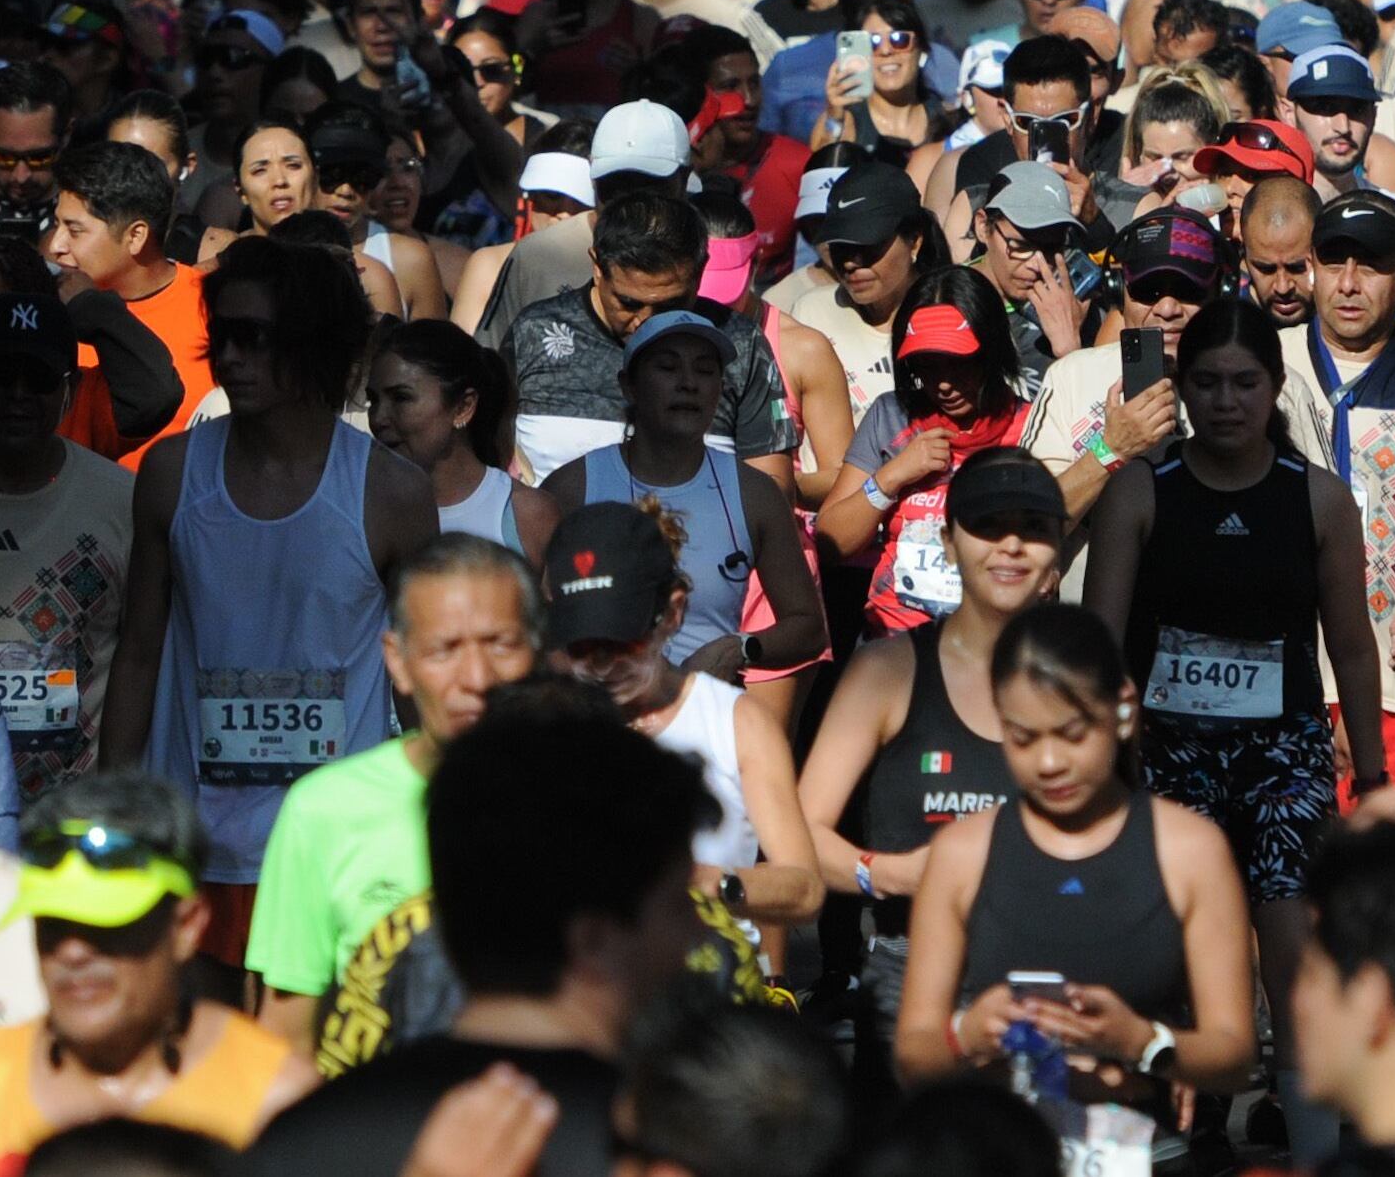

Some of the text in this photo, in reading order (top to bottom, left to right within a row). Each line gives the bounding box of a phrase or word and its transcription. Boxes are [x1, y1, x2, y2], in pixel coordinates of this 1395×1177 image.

[1215, 527, 1250, 536] adidas
[1167, 658, 1260, 691] 16407
[220, 703, 323, 732] 11536
